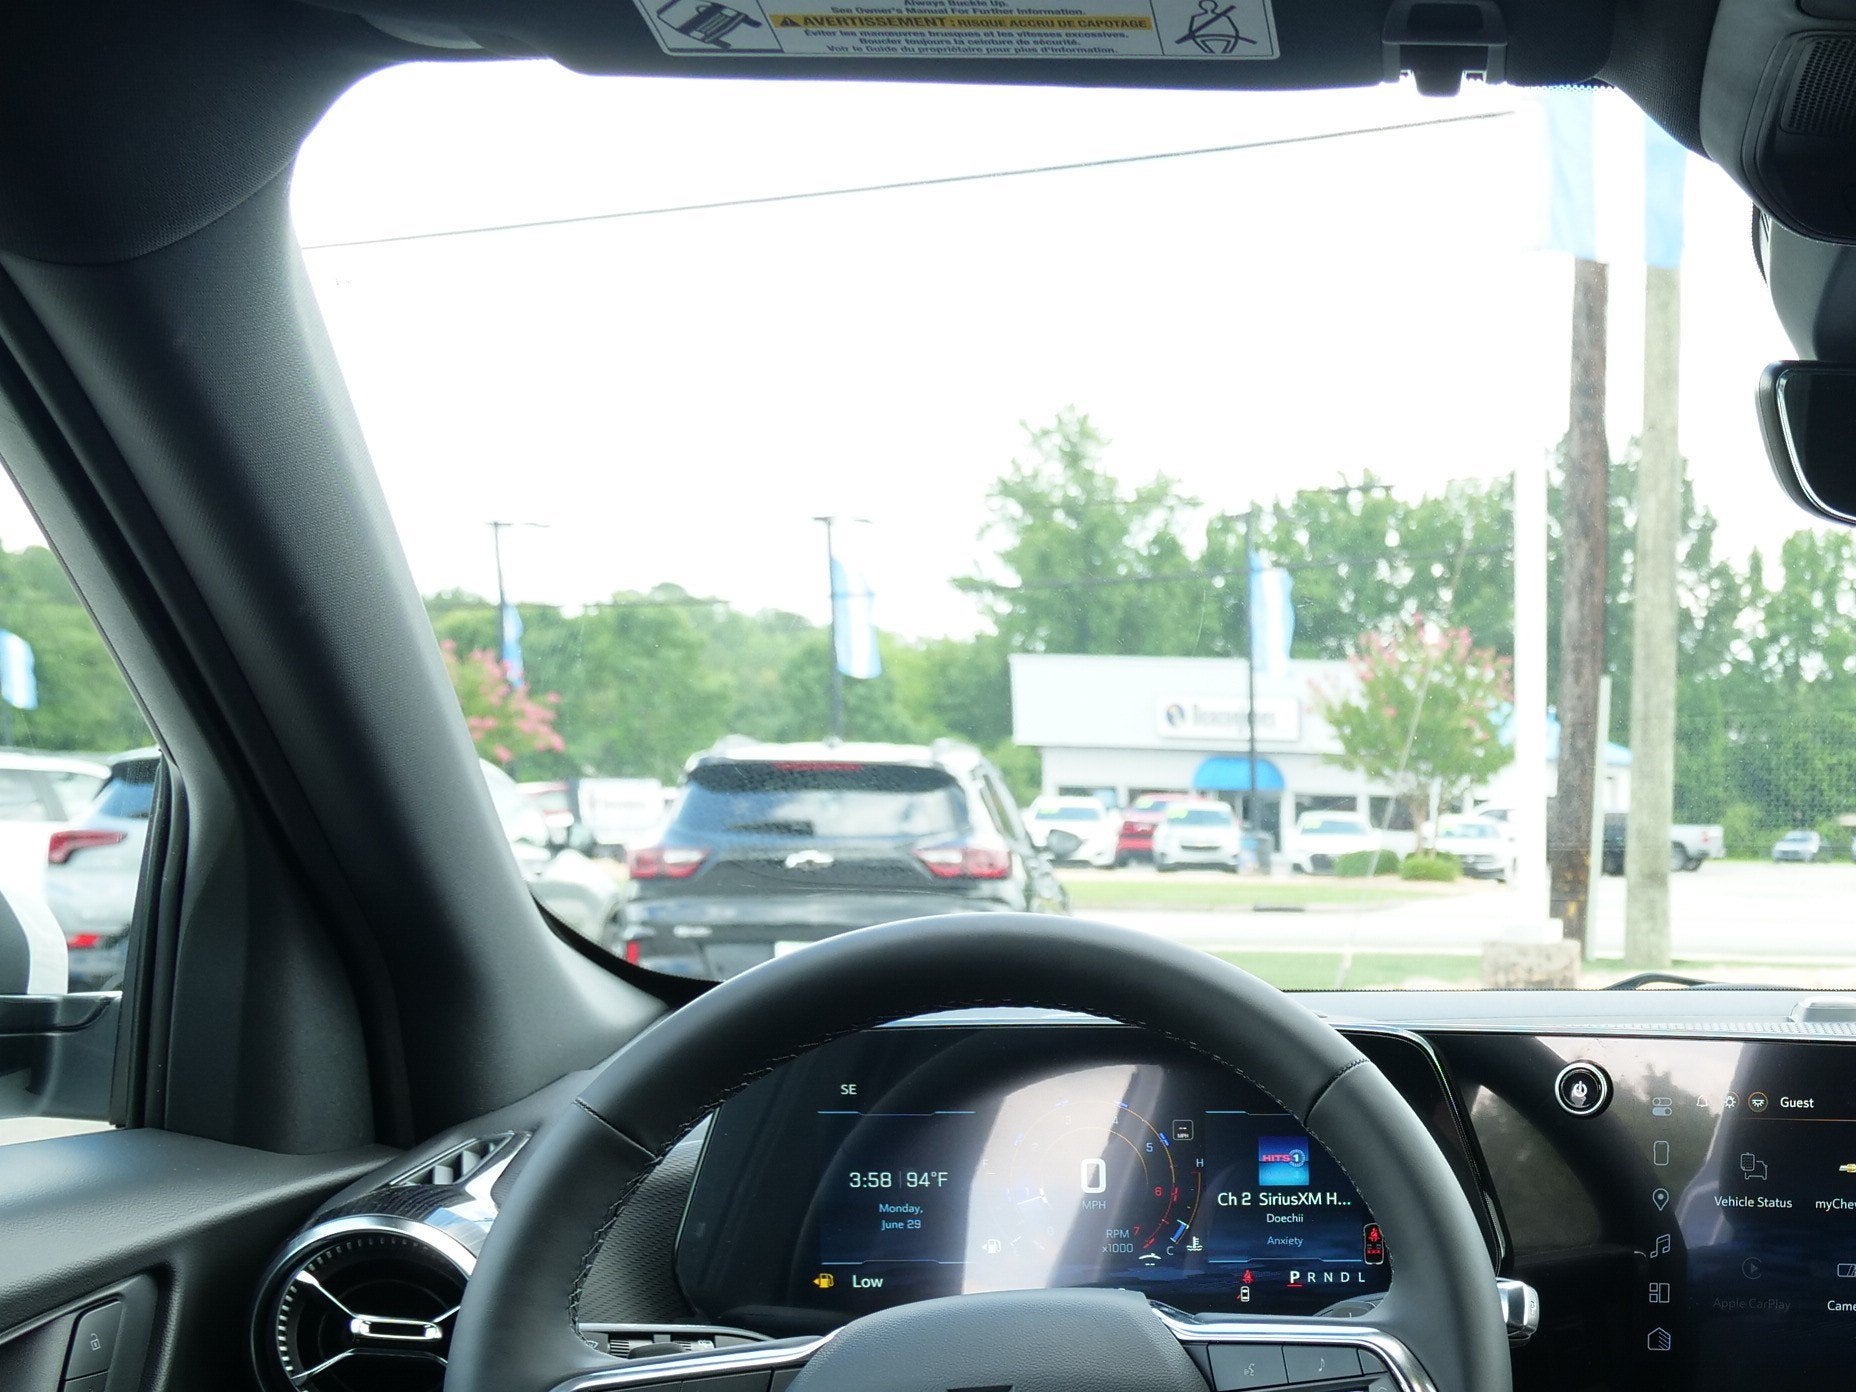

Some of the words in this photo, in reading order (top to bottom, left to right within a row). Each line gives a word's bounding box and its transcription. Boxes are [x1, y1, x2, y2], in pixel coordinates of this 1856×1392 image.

[831, 6, 853, 14] See
[803, 16, 946, 27] AVERTISSEMENT
[957, 19, 1004, 28] RISQUE
[1010, 19, 1054, 28] ACCRU
[1058, 19, 1076, 28] DE
[1078, 19, 1147, 28] CAPOTAGE
[840, 1084, 857, 1095] SE
[1780, 1097, 1814, 1109] Guest
[1146, 1142, 1154, 1152] 5
[1196, 1159, 1204, 1168] H
[1262, 1154, 1291, 1162] HITS
[850, 1172, 892, 1188] 3:58
[906, 1171, 949, 1188] 94°F
[1080, 1158, 1107, 1194] 0
[1155, 1187, 1162, 1197] 6
[1218, 1193, 1237, 1206] Ch
[1242, 1192, 1251, 1206] 2
[1259, 1192, 1322, 1206] SiriusXM
[1326, 1193, 1351, 1205] H...
[1714, 1196, 1754, 1208] Vehicle
[1757, 1197, 1793, 1208] Status
[878, 1203, 923, 1215] Monday,
[1082, 1201, 1106, 1210] MPH
[1267, 1213, 1304, 1223] Doechii
[881, 1219, 904, 1231] June
[907, 1219, 922, 1229] 29
[1107, 1229, 1130, 1239] RPM
[1133, 1226, 1140, 1236] 7
[1267, 1236, 1304, 1247] Anxiety
[1102, 1243, 1134, 1253] x1000
[1167, 1246, 1174, 1255] C
[852, 1274, 884, 1288] Low
[1290, 1271, 1300, 1283] P
[1308, 1273, 1316, 1283] R
[1324, 1273, 1333, 1283] N
[1341, 1272, 1350, 1282] D
[1359, 1272, 1365, 1282] L
[1712, 1298, 1746, 1312] Apple
[1749, 1299, 1791, 1312] CarPlay
